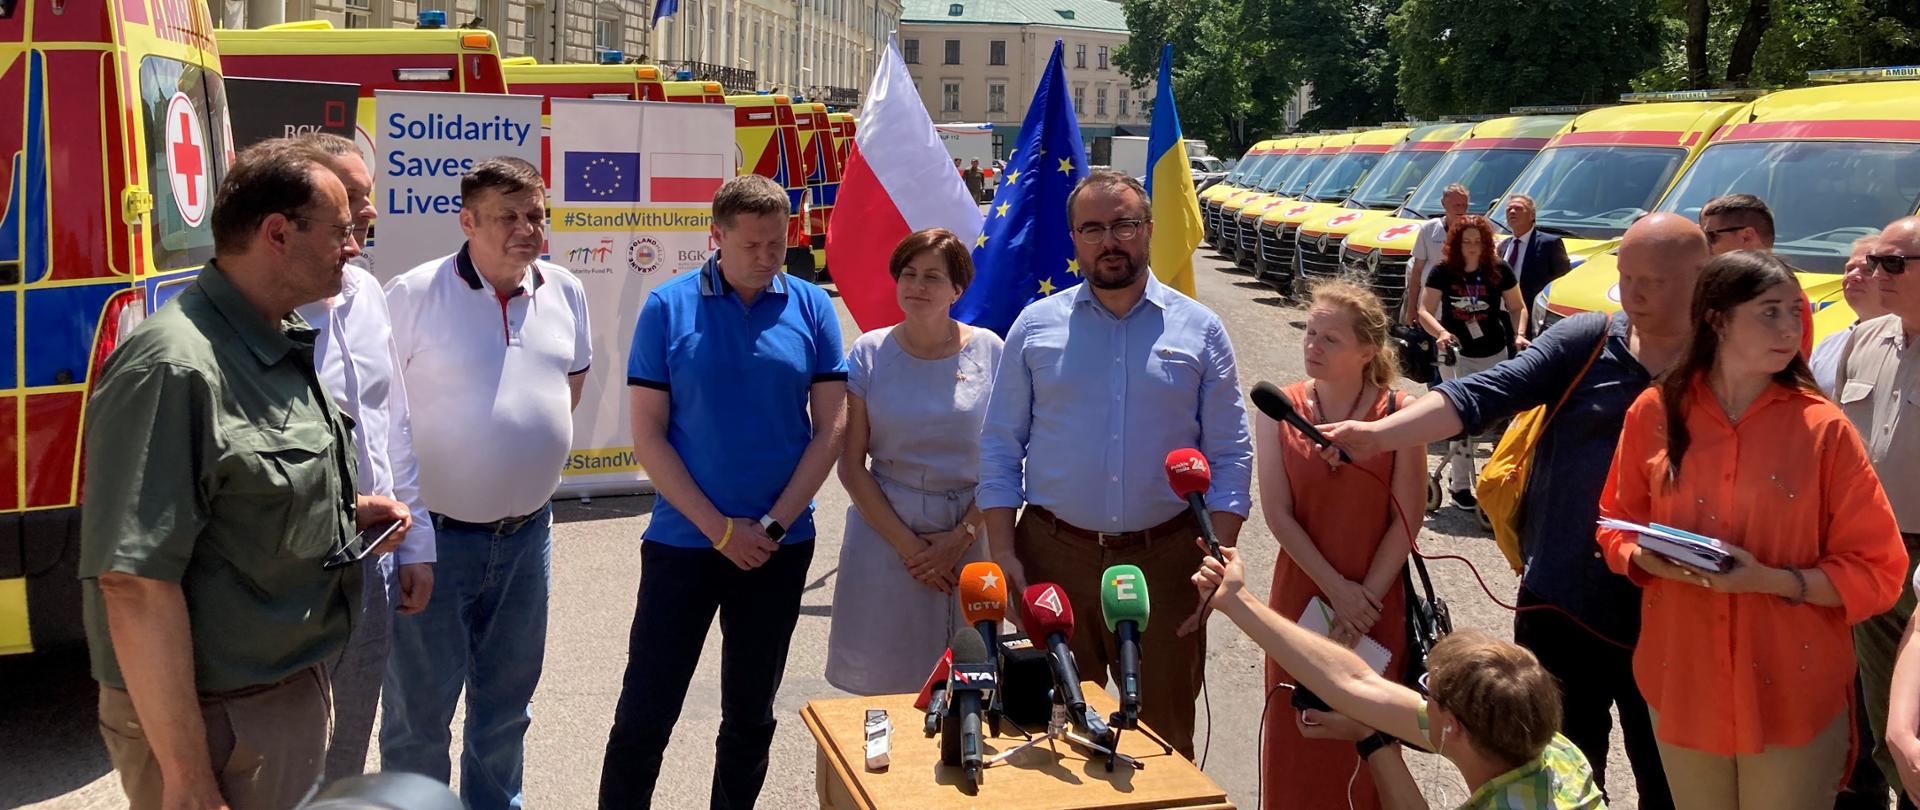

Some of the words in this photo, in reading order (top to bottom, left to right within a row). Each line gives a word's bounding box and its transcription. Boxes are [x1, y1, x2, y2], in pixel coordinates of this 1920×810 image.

[389, 112, 531, 146] Solidarity
[388, 150, 474, 177] Saves
[388, 188, 462, 214] Lives
[564, 212, 714, 228] #StandWithUkrain
[629, 237, 657, 251] POLAND
[678, 250, 706, 261] BGK
[628, 257, 657, 273] UKRAINE
[563, 451, 638, 470] #StandW
[968, 601, 1000, 611] ICTV
